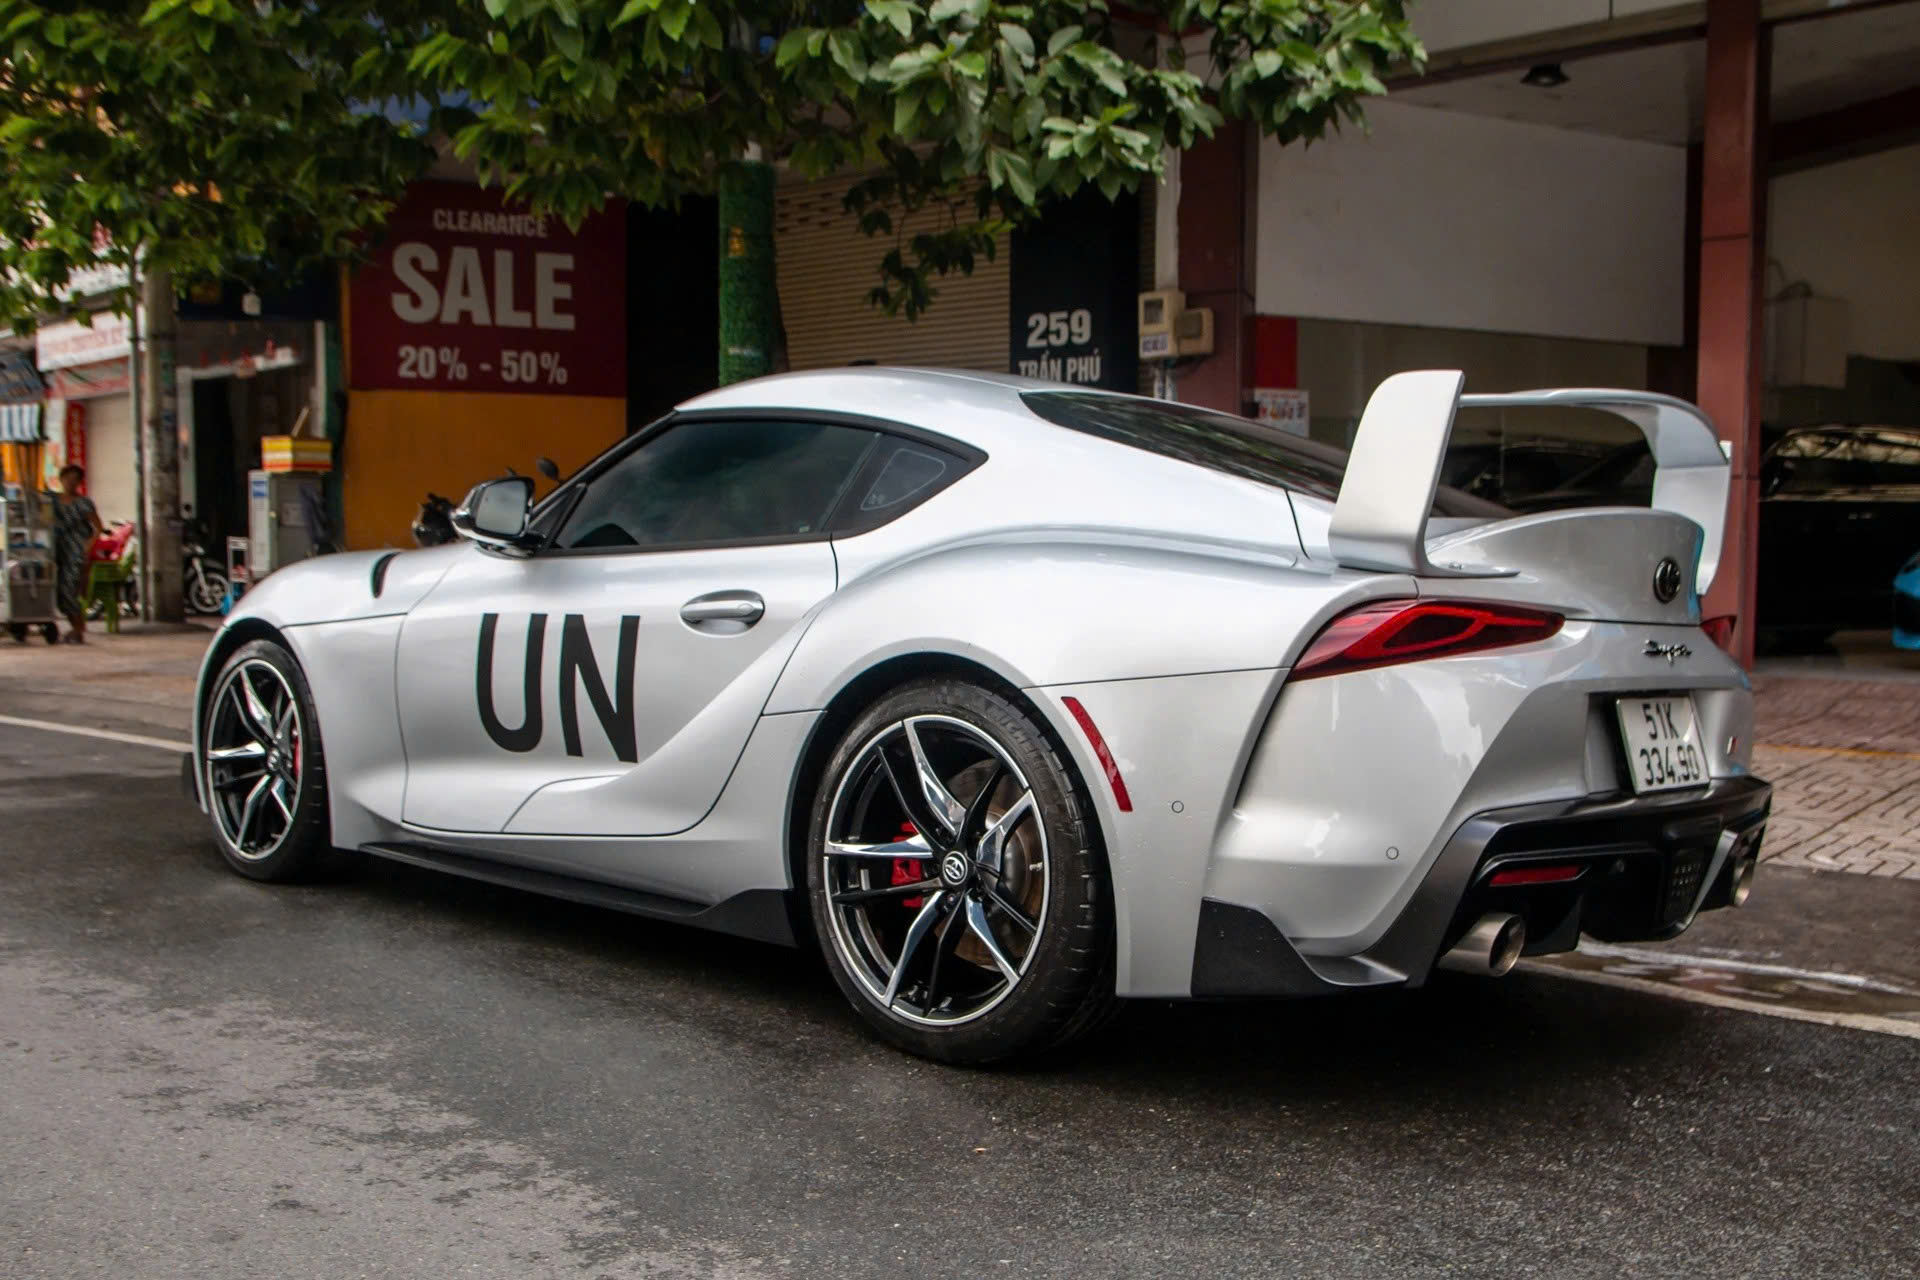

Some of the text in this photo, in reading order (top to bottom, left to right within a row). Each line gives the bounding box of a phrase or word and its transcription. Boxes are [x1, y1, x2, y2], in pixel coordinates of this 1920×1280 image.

[432, 209, 548, 237] CLEARANCE
[391, 243, 576, 331] SALE
[1026, 308, 1092, 349] 259
[397, 345, 468, 380] 20%
[500, 350, 569, 386] 50%
[1066, 348, 1101, 382] PHÚ
[475, 613, 641, 763] UN
[1642, 702, 1680, 740] 51K
[1640, 744, 1701, 786] 334.90
